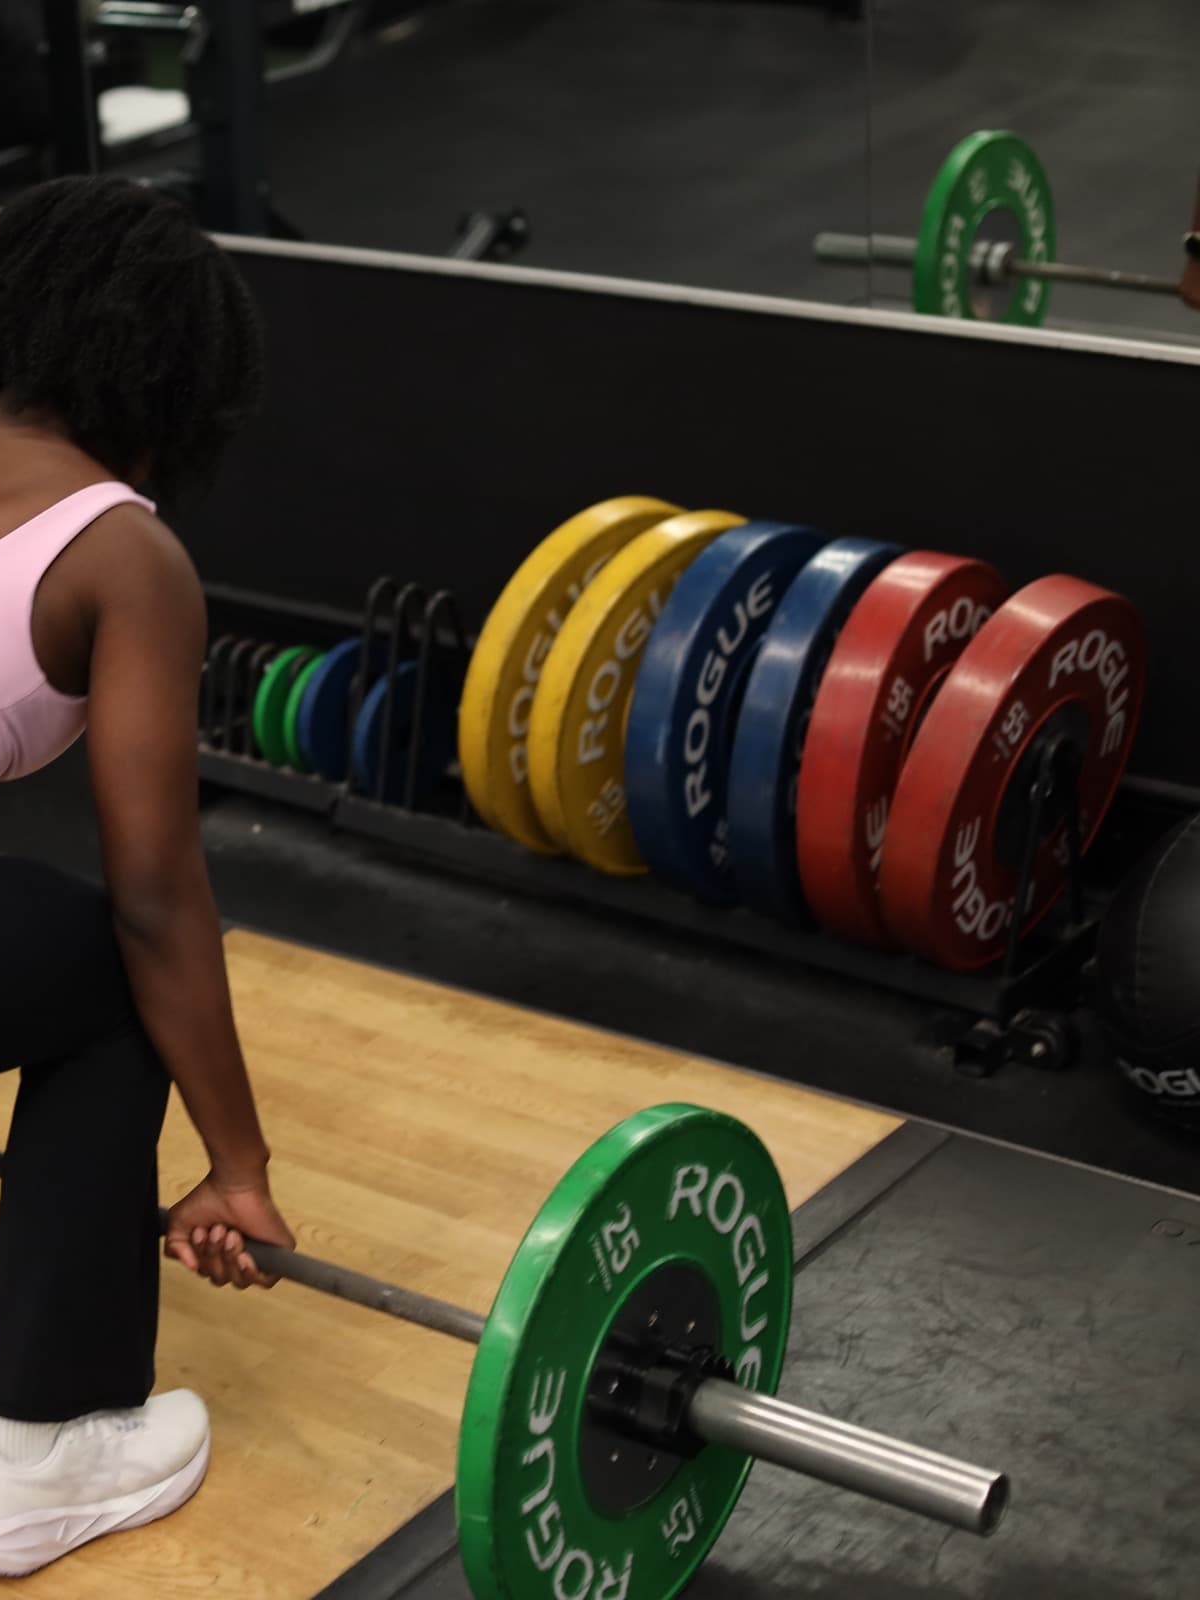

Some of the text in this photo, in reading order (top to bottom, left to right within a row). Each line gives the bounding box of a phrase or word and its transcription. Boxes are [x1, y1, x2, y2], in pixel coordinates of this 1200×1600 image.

[685, 571, 774, 817] ROGUE
[887, 677, 915, 721] 55
[1001, 699, 1031, 745] 55
[1049, 629, 1129, 757] ROGUE
[602, 1203, 641, 1274] 25
[668, 1162, 773, 1393] ROGUE
[522, 1366, 633, 1600] ROGUE
[661, 1498, 696, 1558] 25
